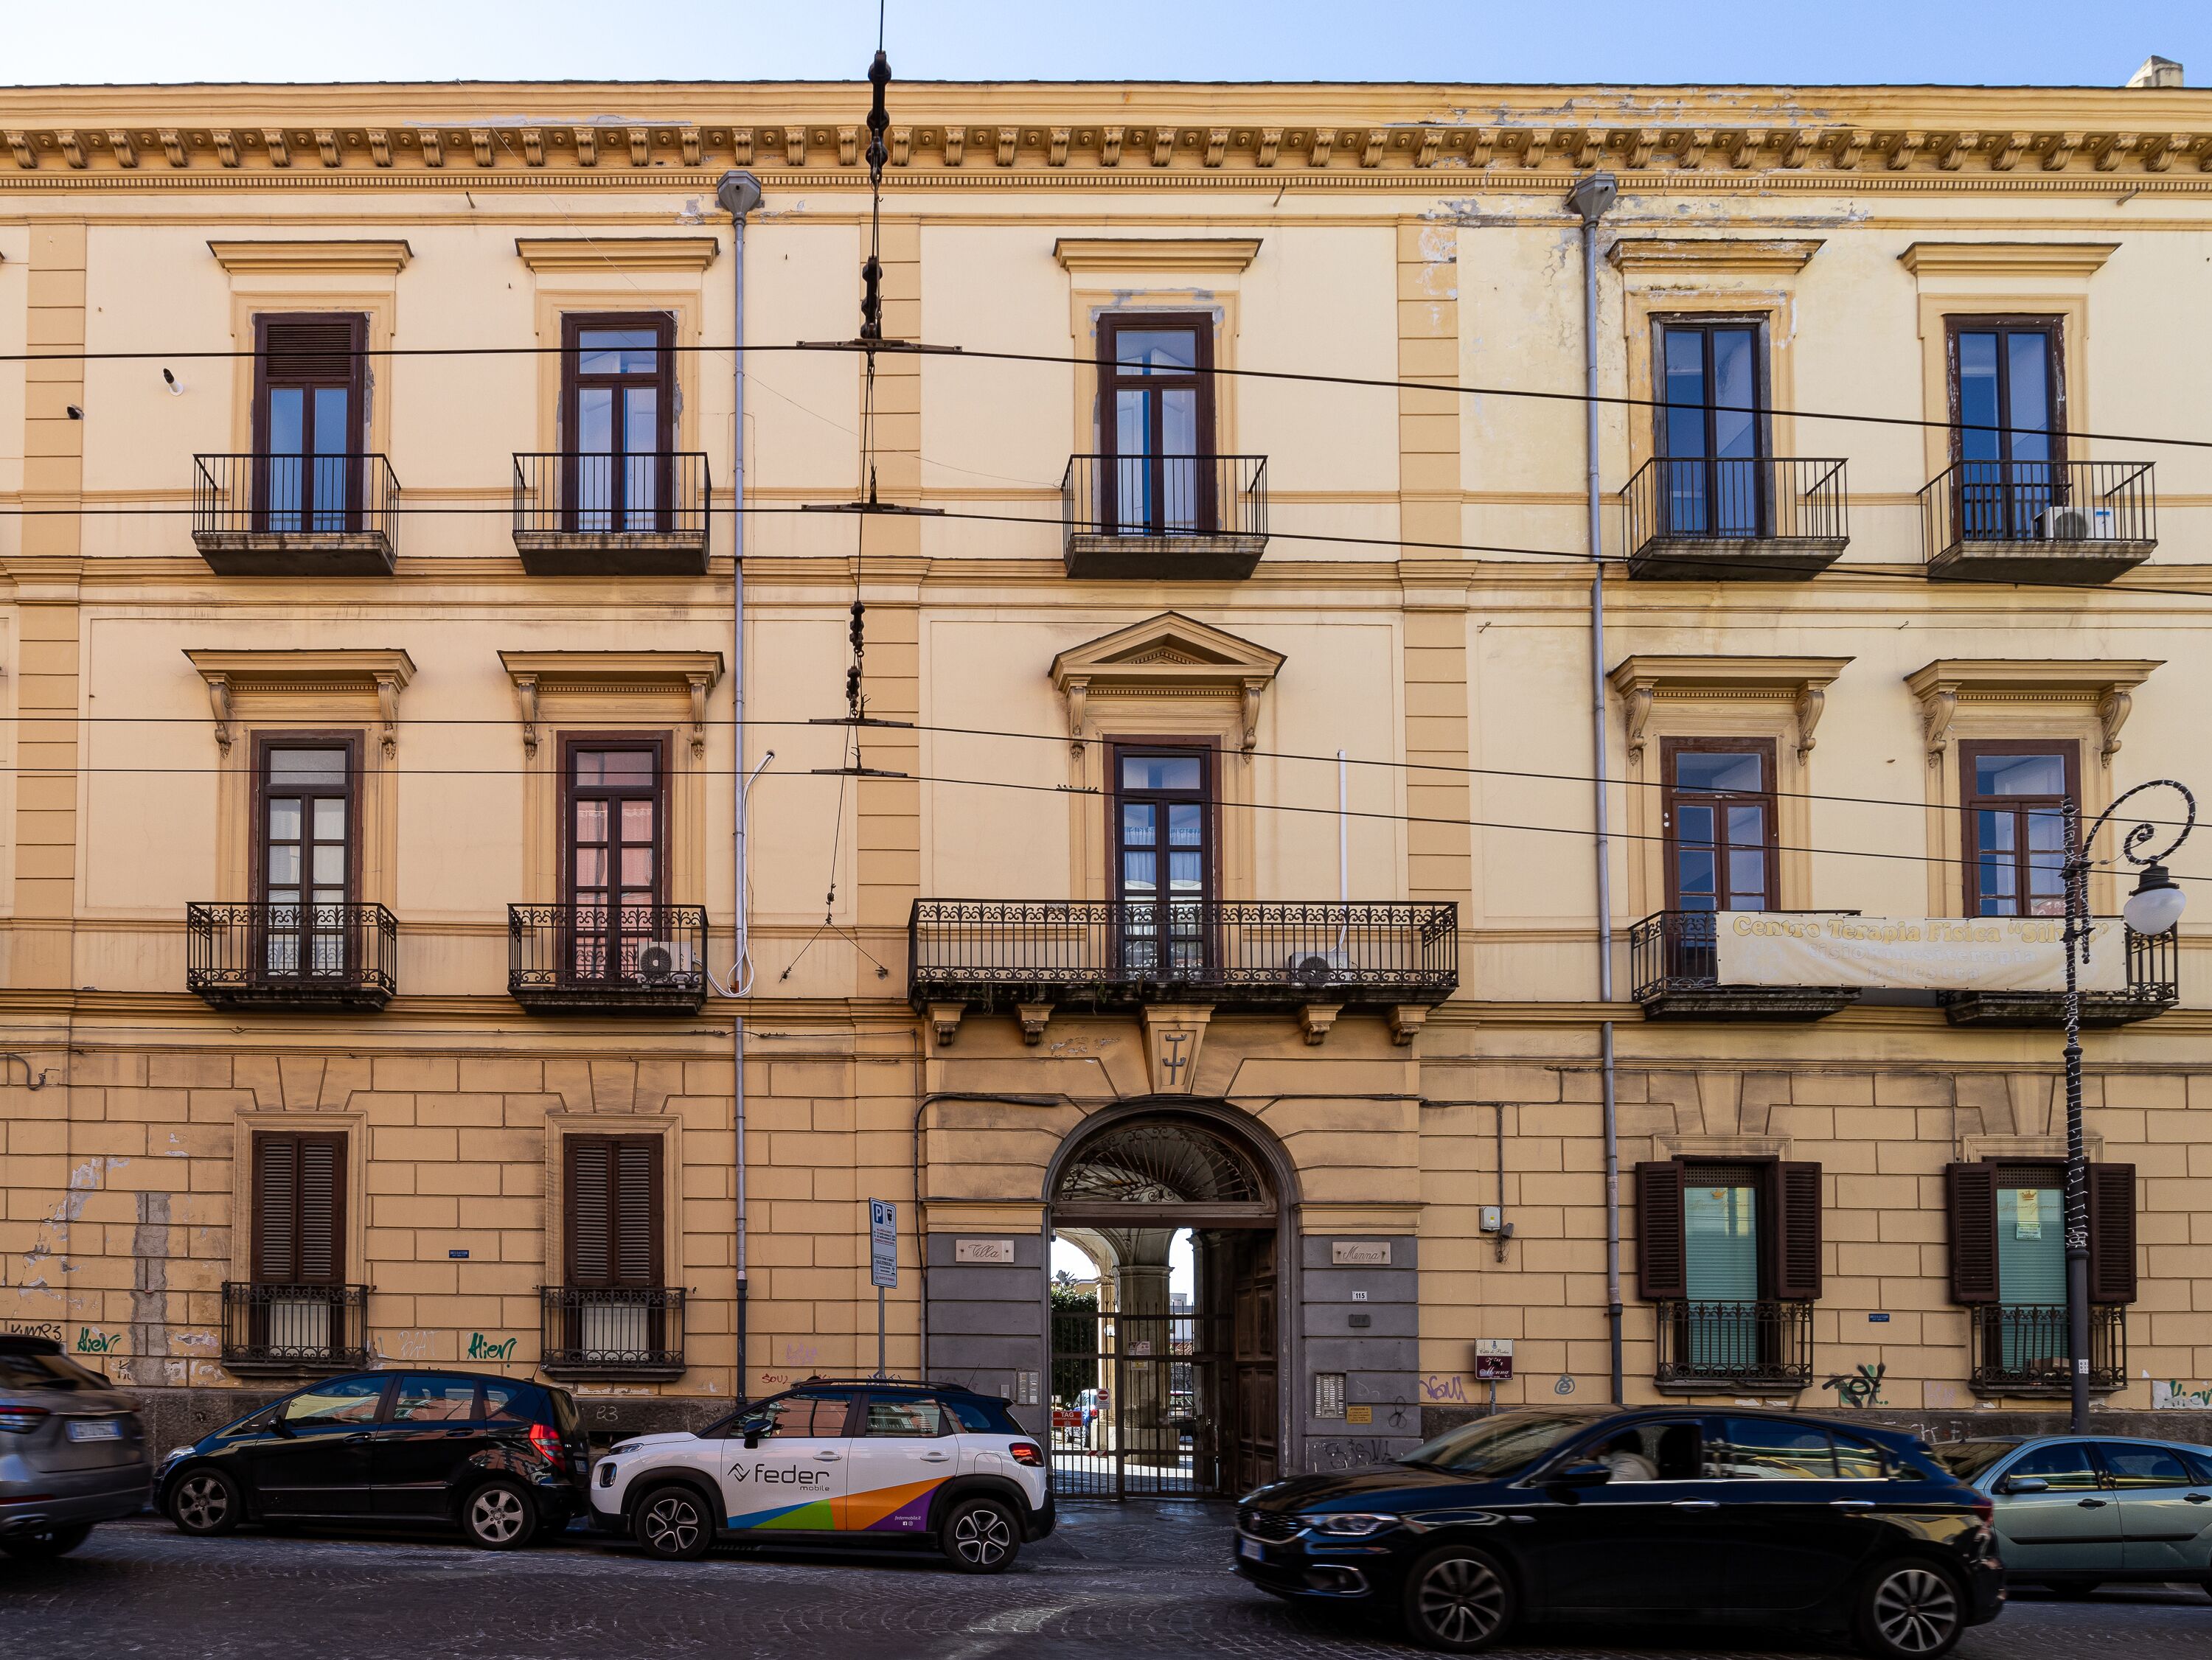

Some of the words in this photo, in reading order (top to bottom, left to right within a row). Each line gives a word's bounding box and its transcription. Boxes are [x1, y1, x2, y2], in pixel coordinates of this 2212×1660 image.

[1733, 916, 1820, 938] Centro
[1827, 919, 1921, 945] Terapia
[1927, 921, 2002, 943] Fisica
[1866, 964, 1980, 981] palestra
[875, 1205, 882, 1221] P
[968, 1244, 1000, 1258] Villa
[1343, 1246, 1380, 1260] Menna
[755, 1463, 830, 1485] feder
